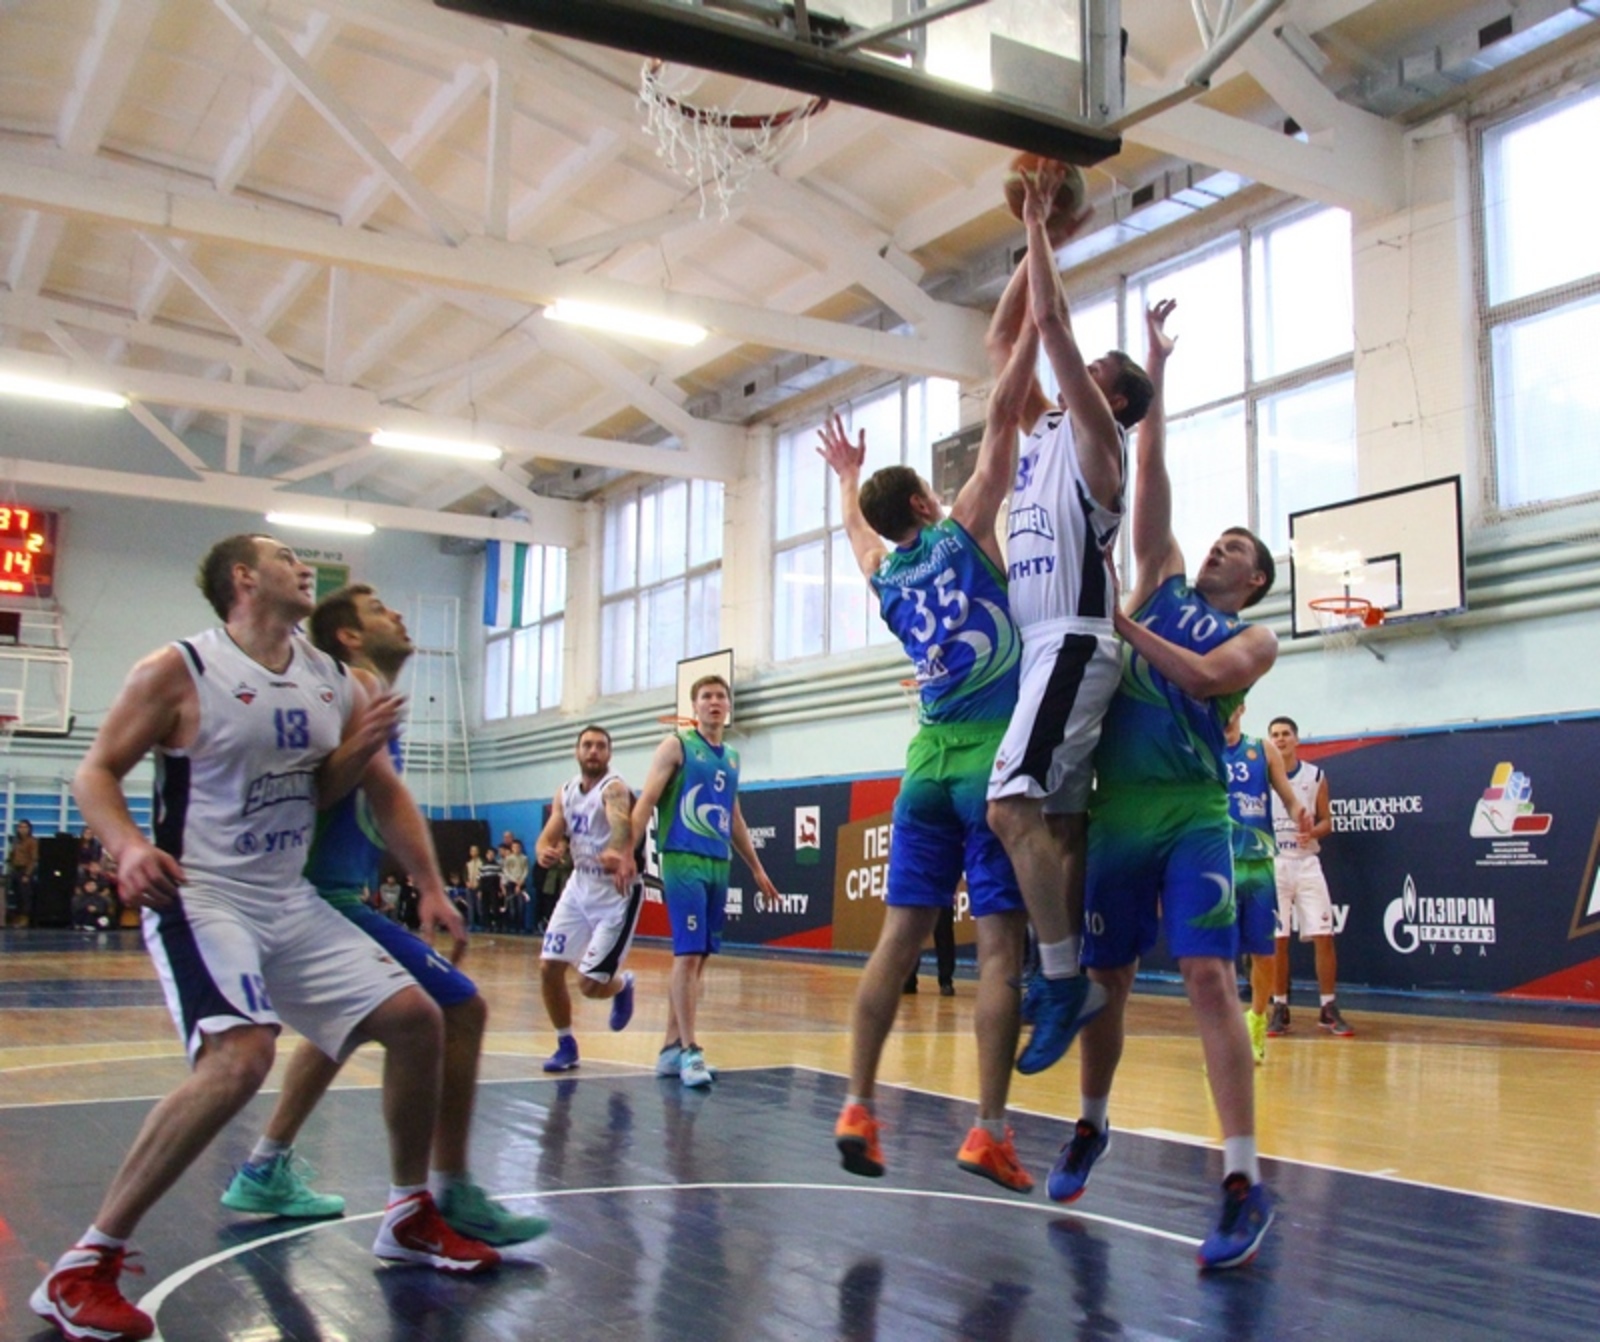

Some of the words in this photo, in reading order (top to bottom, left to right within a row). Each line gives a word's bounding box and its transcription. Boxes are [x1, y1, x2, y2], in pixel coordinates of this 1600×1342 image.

[26, 533, 45, 553] 2
[4, 551, 32, 574] 14
[1007, 556, 1056, 582] ГНТУ
[902, 567, 969, 642] 35
[1177, 604, 1218, 642] 10
[274, 708, 310, 749] 13
[713, 770, 727, 792] 5
[864, 822, 895, 860] ПЕ
[686, 915, 698, 931] 5
[1418, 897, 1496, 925] ГАЗПРОМ
